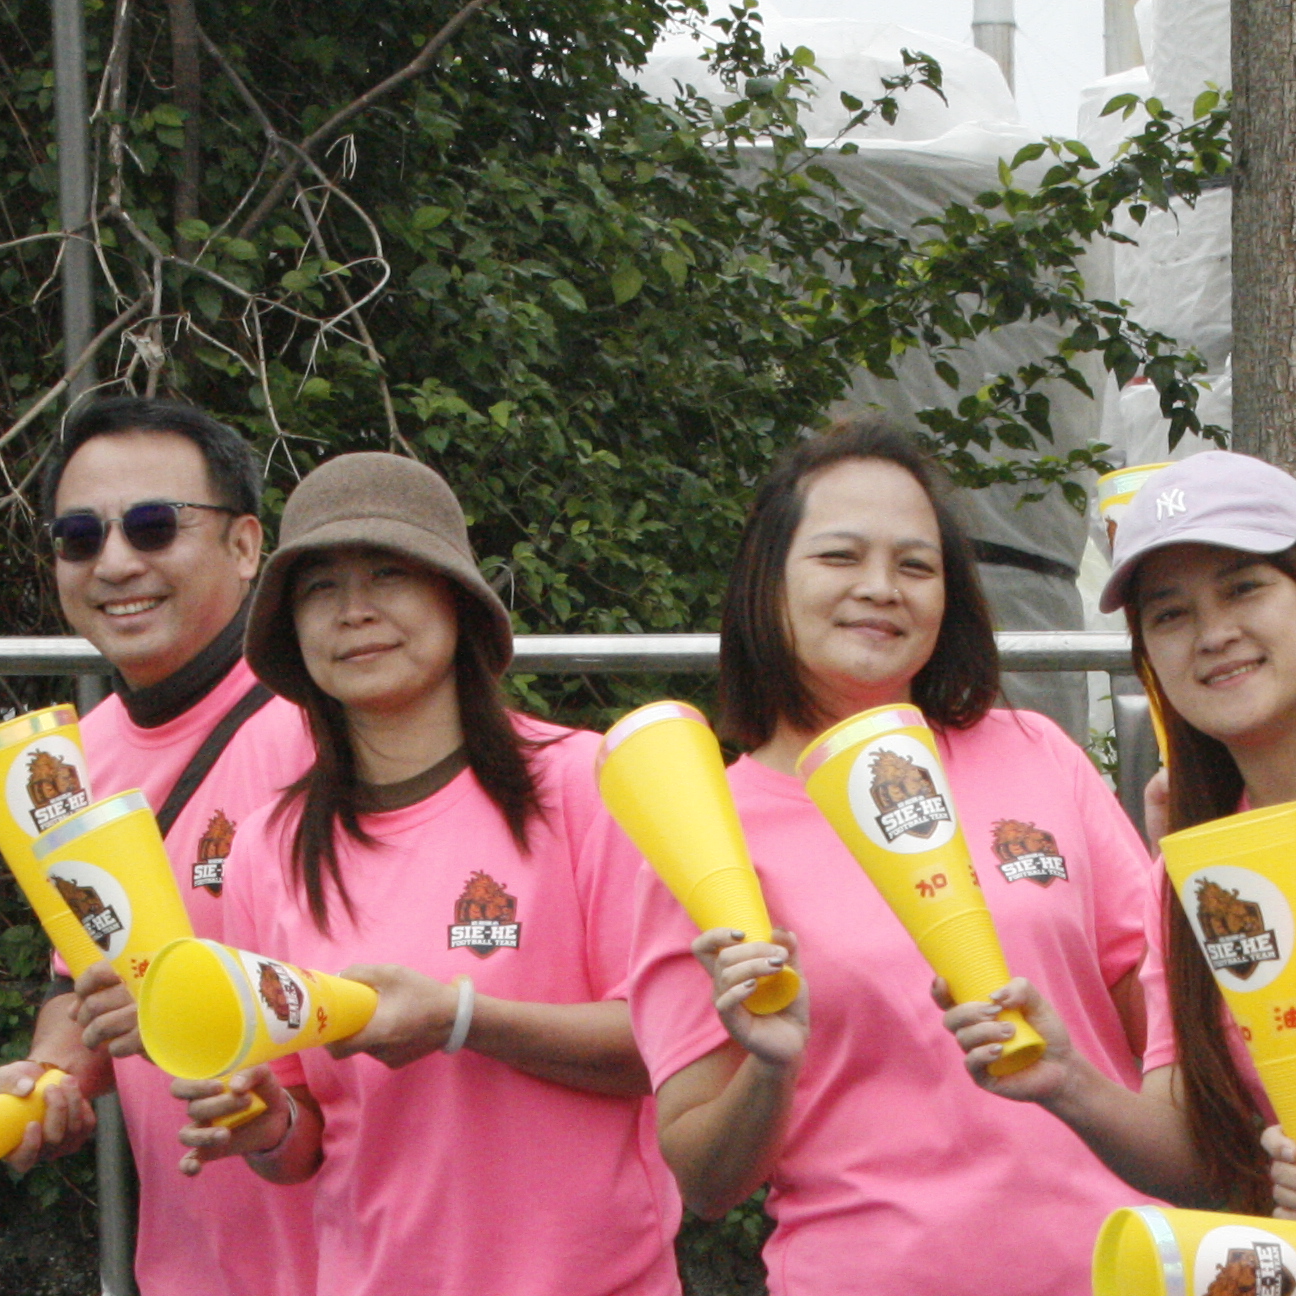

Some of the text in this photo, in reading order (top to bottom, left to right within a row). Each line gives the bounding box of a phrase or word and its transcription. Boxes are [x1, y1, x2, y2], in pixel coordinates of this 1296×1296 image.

[1156, 489, 1186, 520] NY
[34, 791, 87, 825] SIE-HE
[881, 797, 946, 832] SIE-HE
[1001, 856, 1065, 877] SIE-HE
[451, 924, 518, 940] SIE-HE
[1207, 933, 1274, 960] SIE-HE
